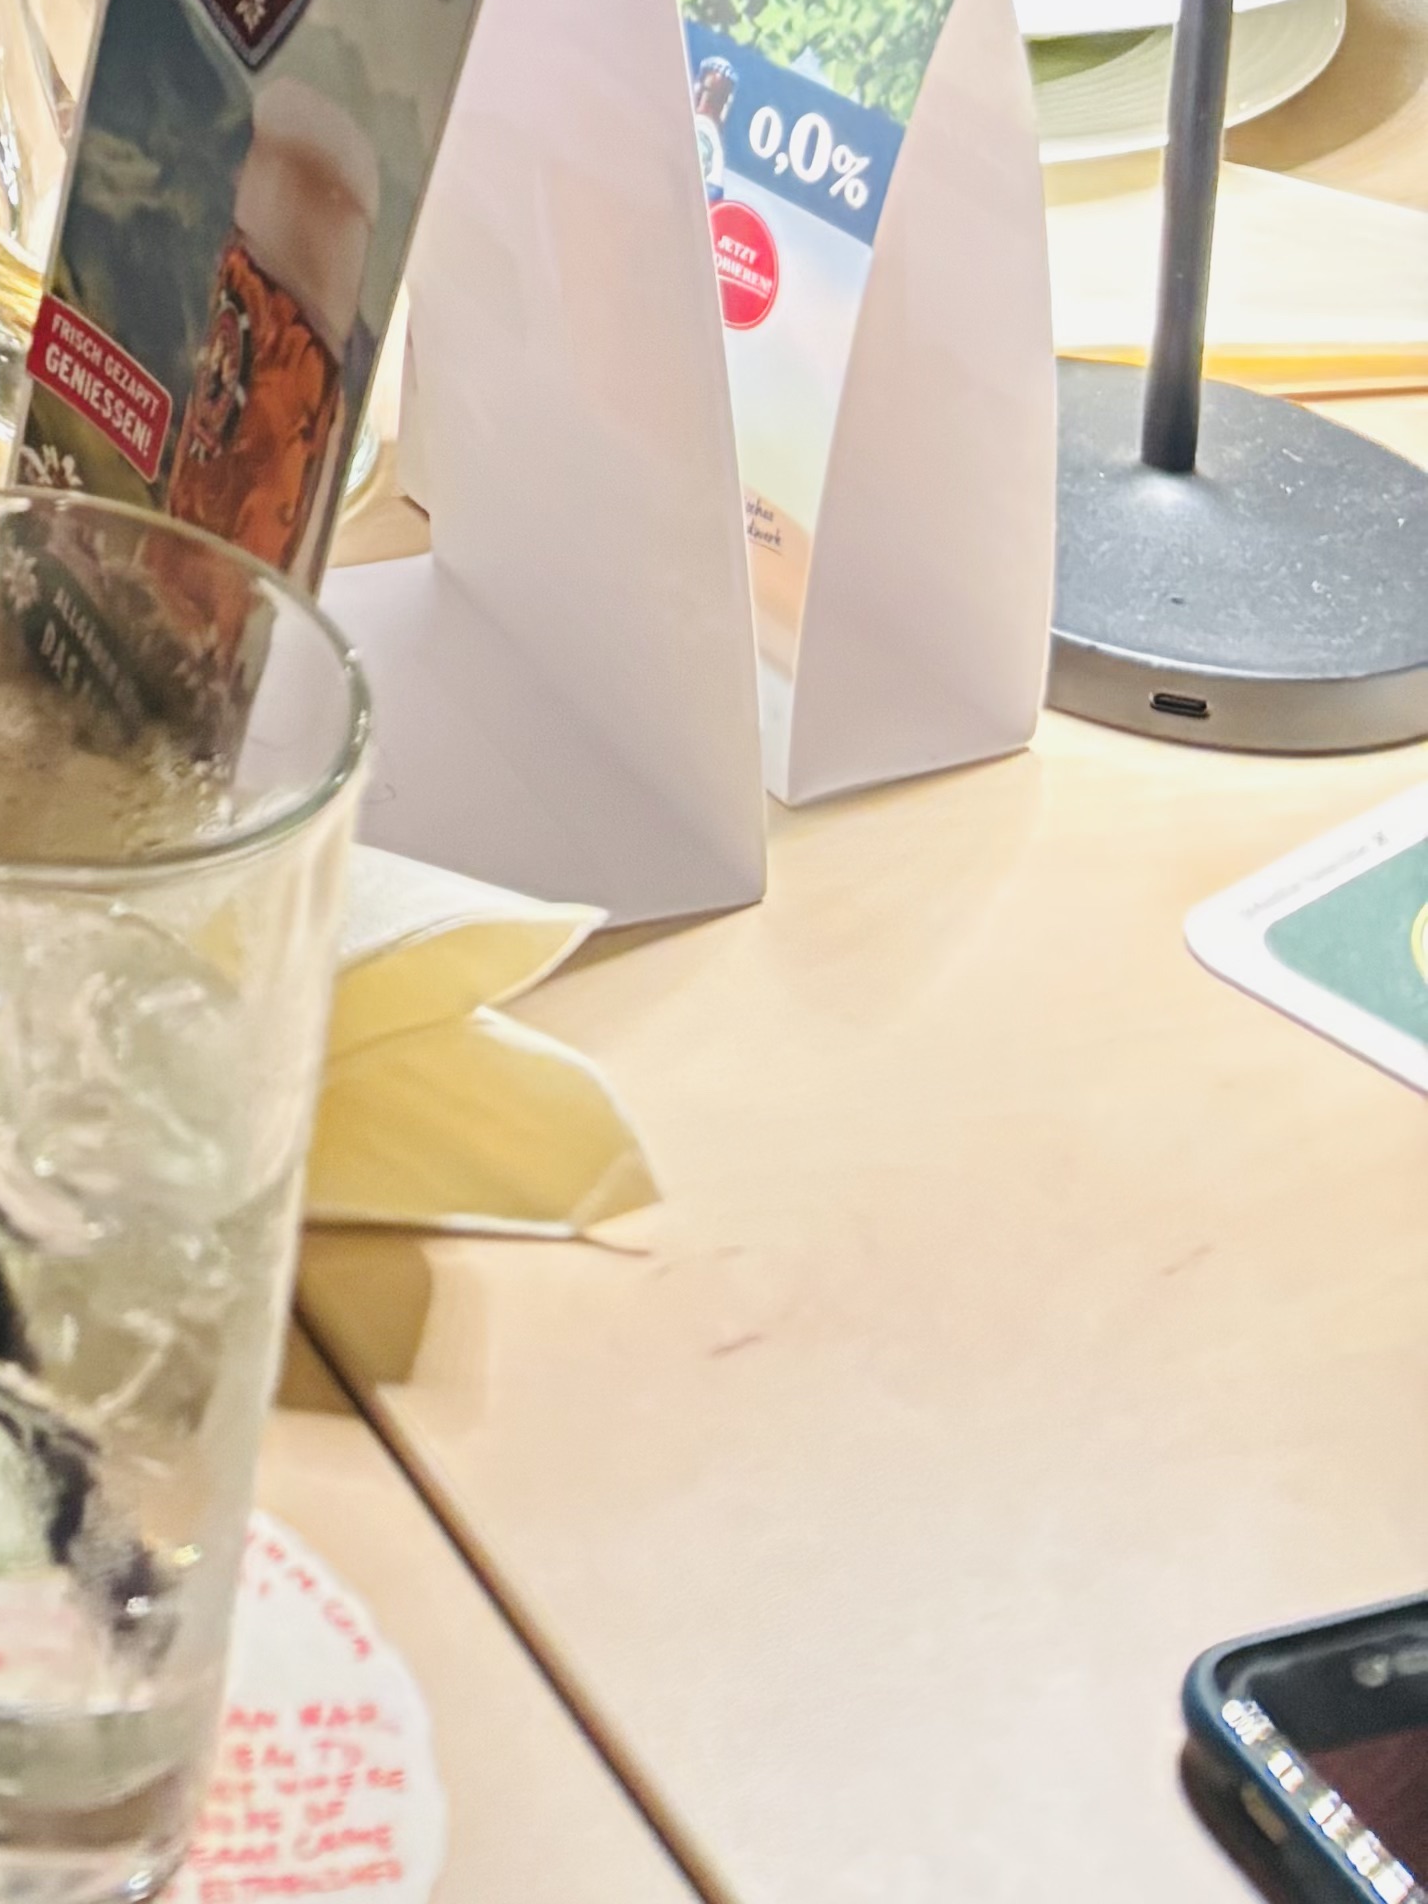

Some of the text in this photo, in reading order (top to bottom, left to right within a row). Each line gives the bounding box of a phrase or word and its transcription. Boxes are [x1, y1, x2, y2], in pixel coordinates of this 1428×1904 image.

[748, 105, 871, 210] 0,0%
[717, 235, 757, 265] JETZT
[45, 342, 153, 457] GENIESSEN!
[51, 313, 161, 418] FRISCH GEZAPFT
